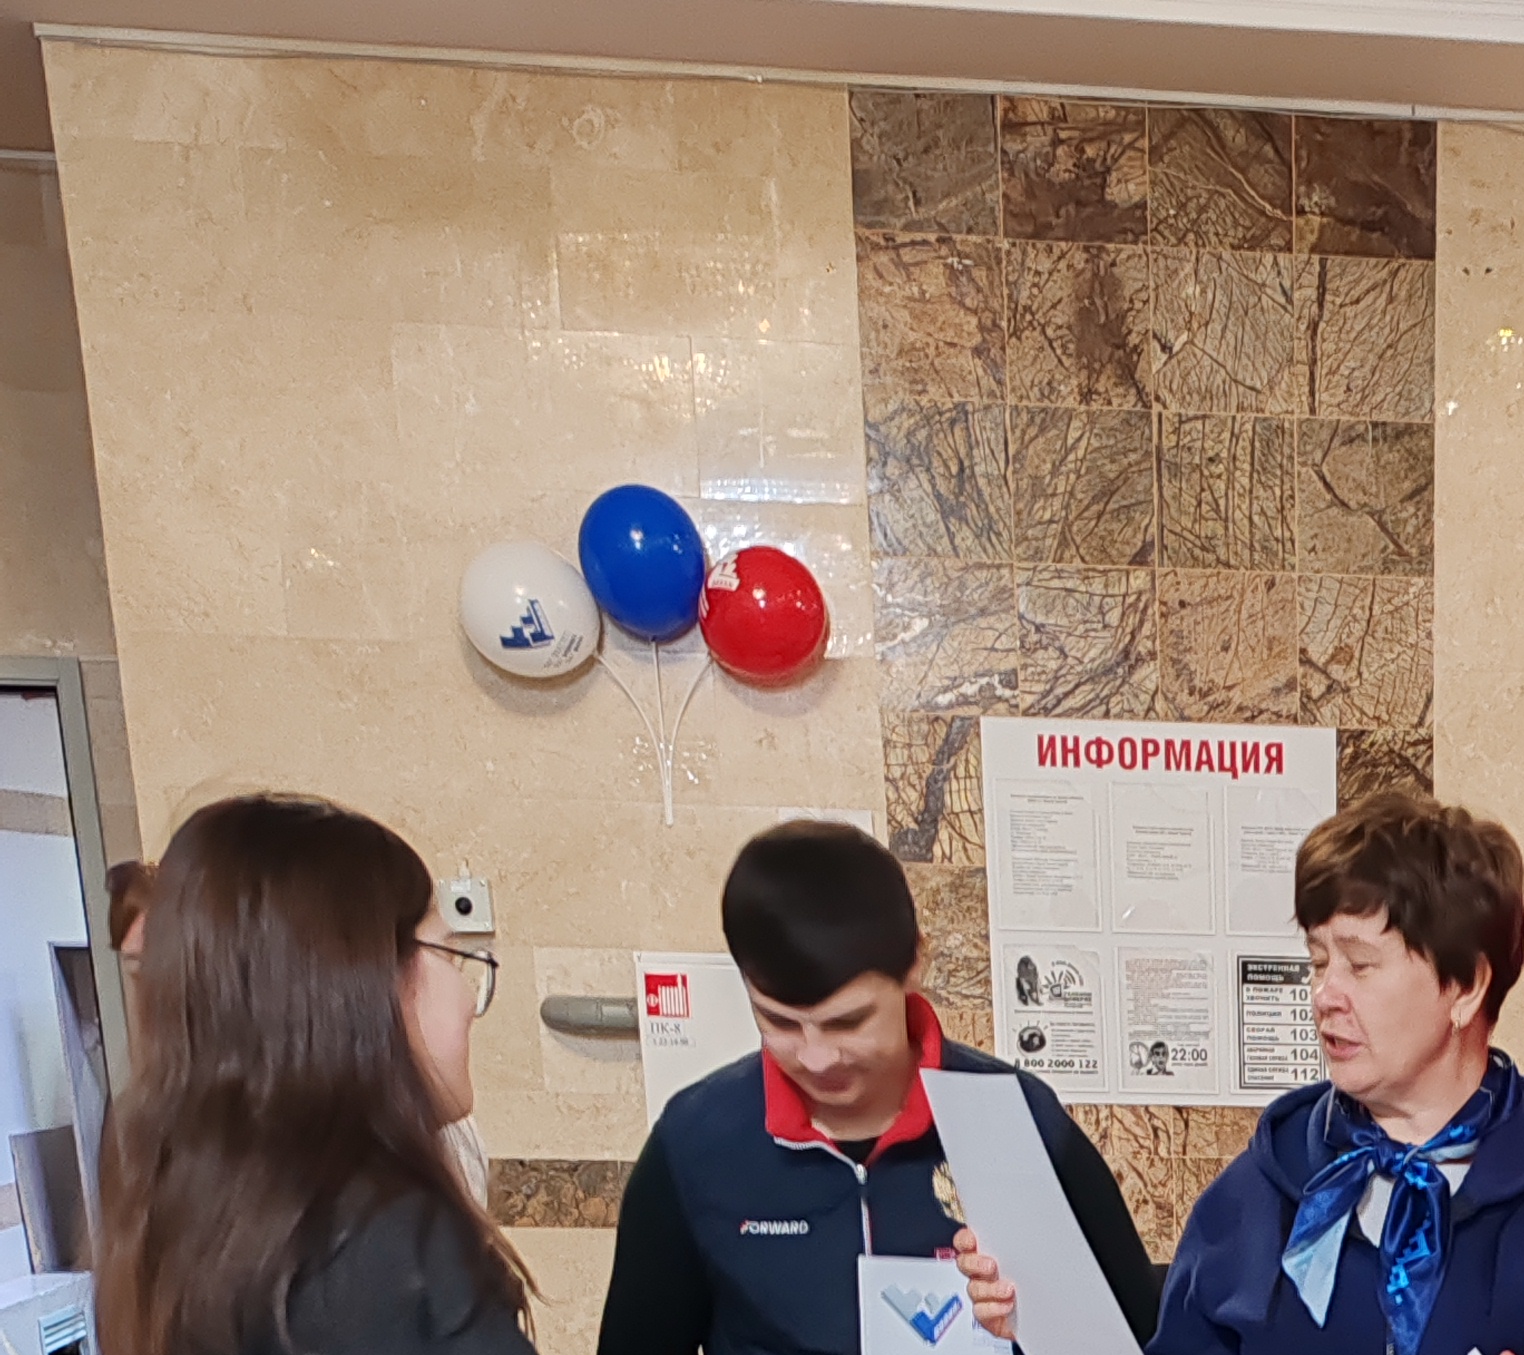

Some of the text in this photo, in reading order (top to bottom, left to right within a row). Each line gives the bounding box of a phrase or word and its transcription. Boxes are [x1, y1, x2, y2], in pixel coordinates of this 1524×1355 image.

[1036, 733, 1285, 780] ИНФОРМАЦИЯ
[1290, 988, 1312, 1002] 10
[1290, 1028, 1318, 1041] 103
[1171, 1047, 1208, 1061] 22:00
[1290, 1048, 1319, 1061] 104
[1024, 1058, 1044, 1068] 800
[1047, 1058, 1075, 1068] 2000
[1079, 1058, 1098, 1069] 122
[1291, 1067, 1319, 1081] 112
[740, 1219, 809, 1235] FORWARD
